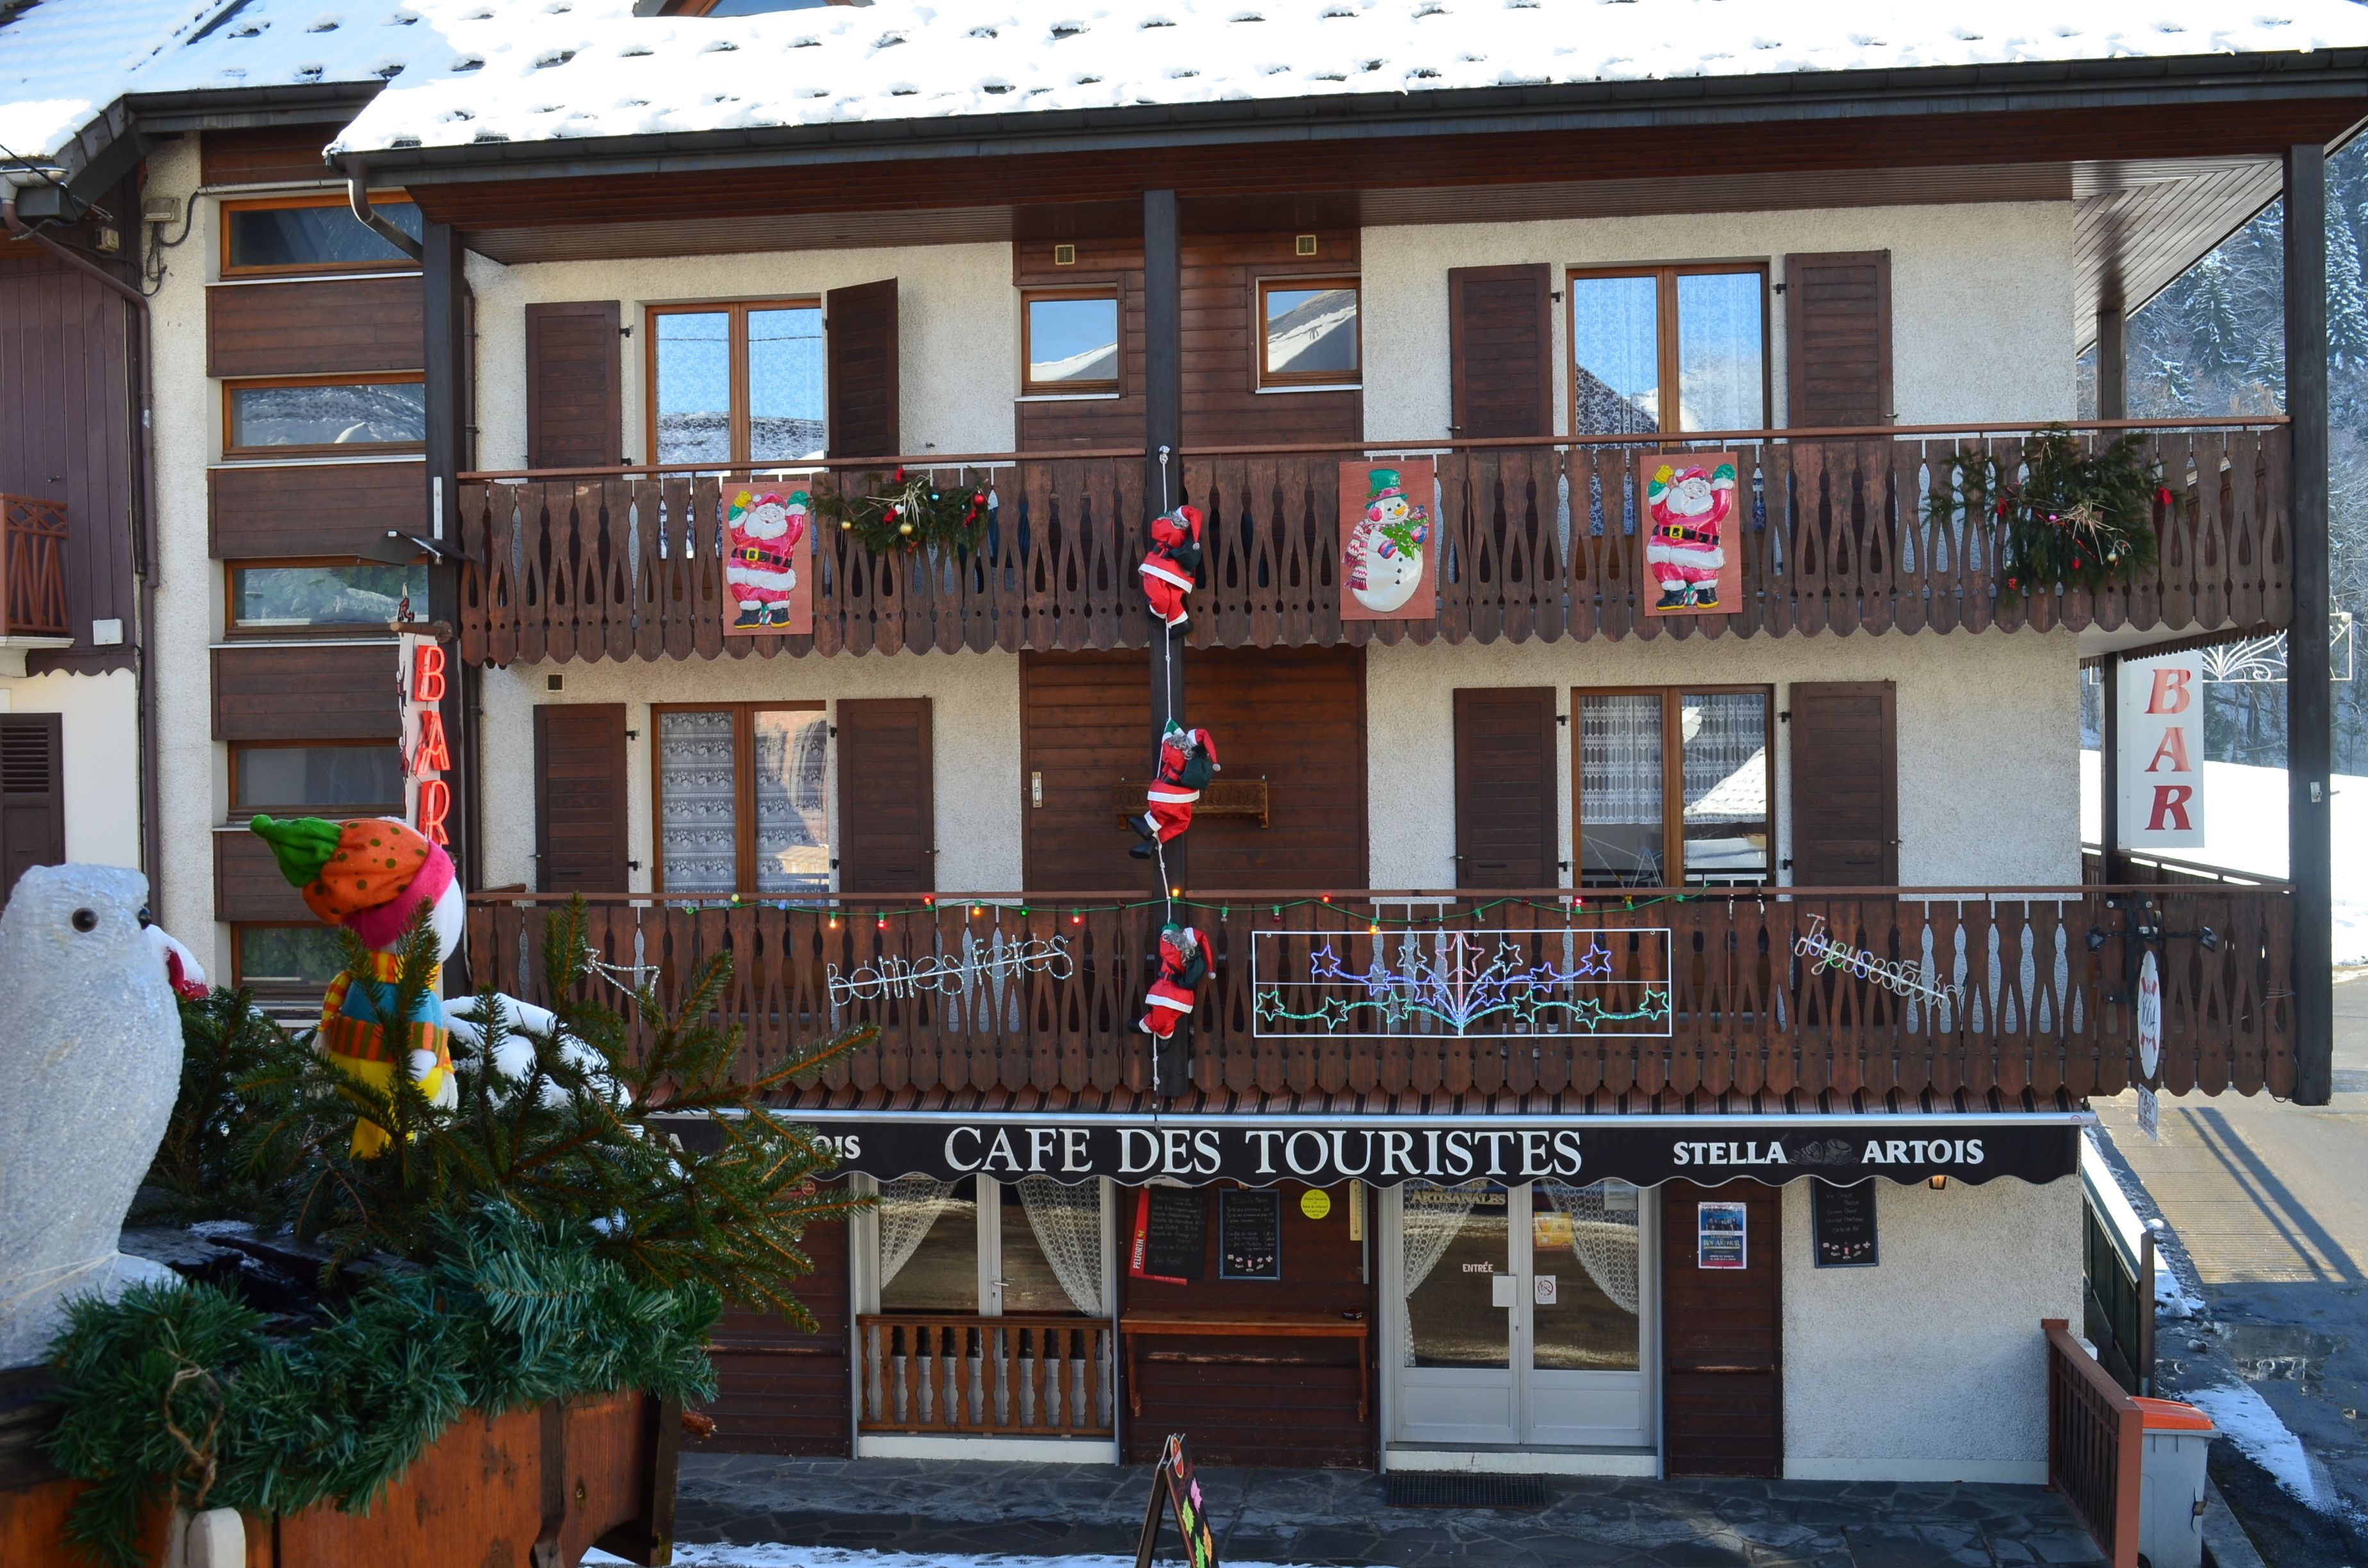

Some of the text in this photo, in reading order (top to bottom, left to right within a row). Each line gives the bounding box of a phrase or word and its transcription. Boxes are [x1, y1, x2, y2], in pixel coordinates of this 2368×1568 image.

[413, 644, 450, 845] BAR
[2144, 668, 2193, 831] BAR
[944, 1127, 1583, 1176] CAFE DES TOURISTES
[1673, 1139, 1985, 1165] STELLA ARTOIS
[1411, 1189, 1506, 1205] ARTISANALES
[1133, 1238, 1144, 1270] PELFORTH
[1462, 1261, 1494, 1273] ENTRÉE
